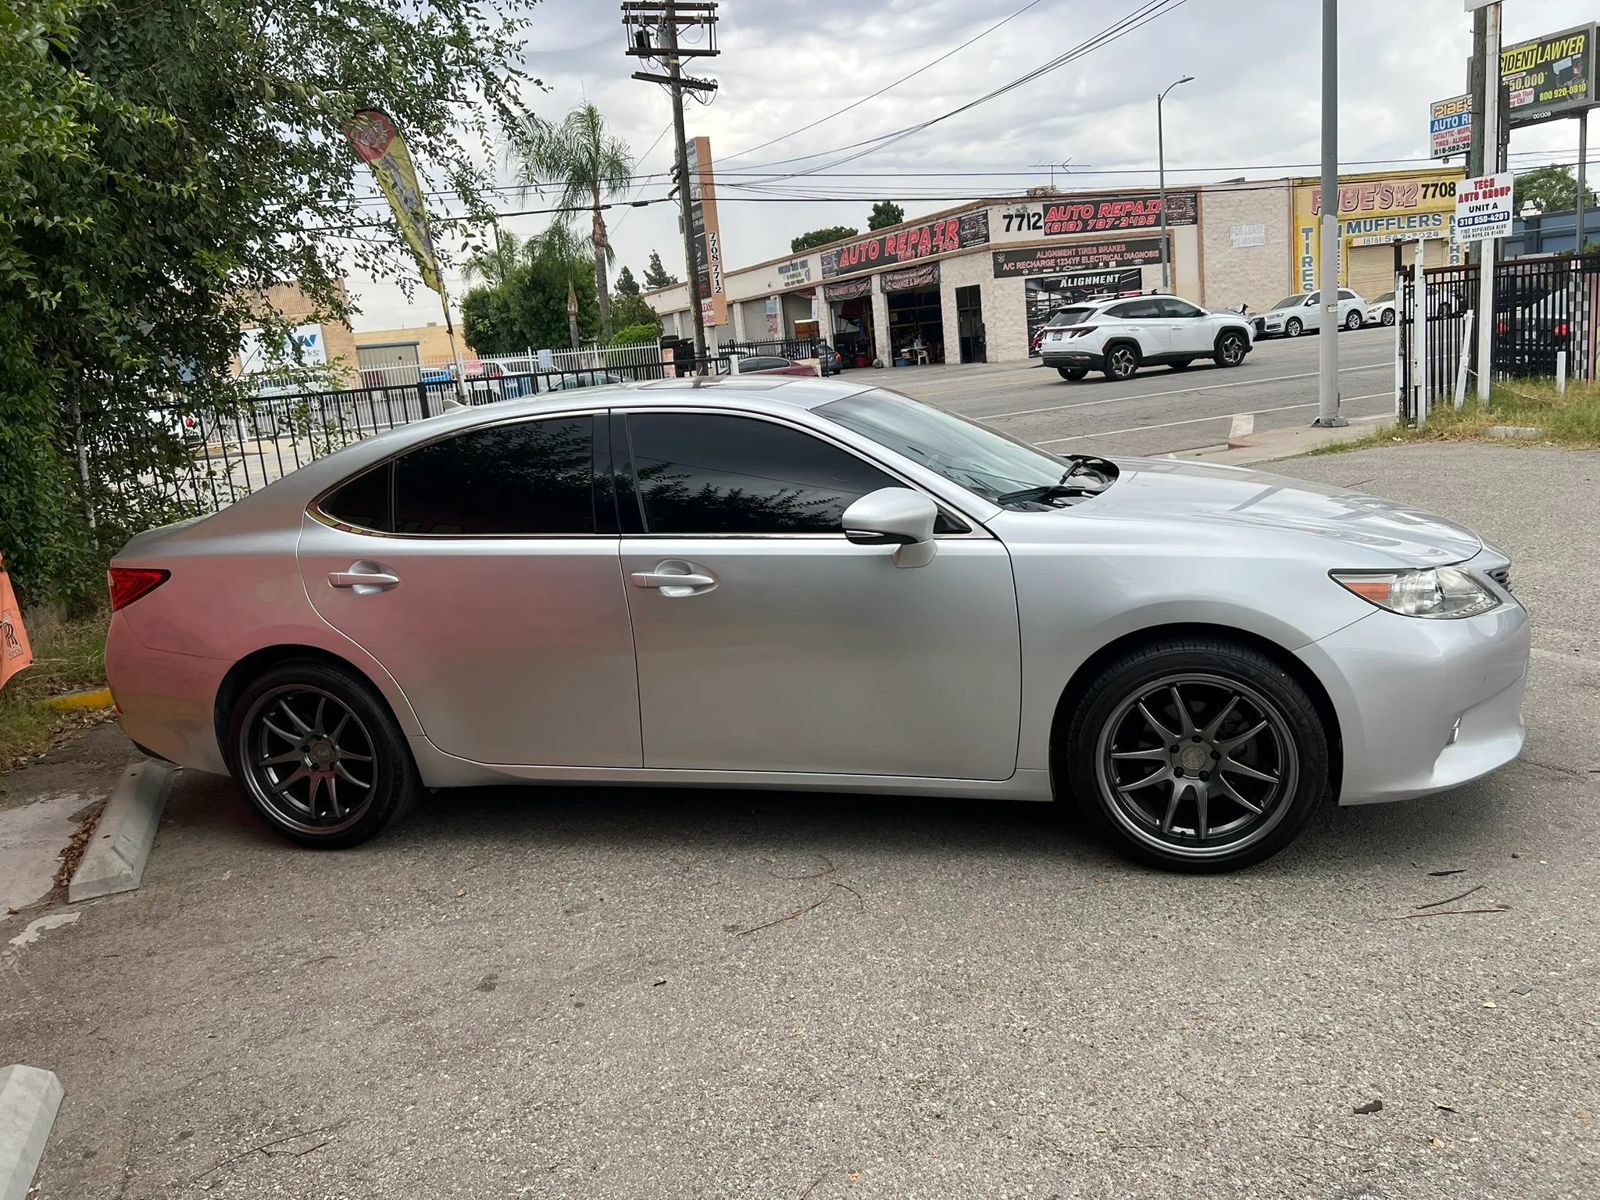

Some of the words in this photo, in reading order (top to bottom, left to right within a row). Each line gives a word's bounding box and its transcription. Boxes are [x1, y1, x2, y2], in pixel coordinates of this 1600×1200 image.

[1537, 35, 1585, 64] LAWYER
[1540, 91, 1552, 101] 800
[1433, 116, 1459, 132] AUTO
[1436, 139, 1449, 147] TIRES
[1421, 181, 1456, 200] 7708
[1474, 178, 1495, 190] TECH
[1458, 191, 1479, 203] AUTO
[1482, 186, 1511, 199] GROUP
[1045, 204, 1095, 222] AUTO
[1469, 203, 1490, 213] UNIT
[1492, 202, 1498, 210] A
[1002, 211, 1043, 232] 7712
[1347, 213, 1442, 235] MUFFLERS
[1460, 216, 1472, 226] 310
[839, 241, 880, 267] AUTO
[885, 219, 959, 257] REPAIR
[1036, 247, 1076, 259] ALIGNMENT
[1078, 246, 1097, 255] TIRES
[1098, 244, 1126, 254] BRAKES
[1003, 262, 1015, 271] A/C
[1016, 258, 1056, 270] RECHARGE
[1081, 253, 1122, 264] ELECTRICAL
[1123, 250, 1159, 260] DIAGNOSIS
[1302, 228, 1314, 294] TIRES
[1060, 273, 1120, 288] ALIGNMENT
